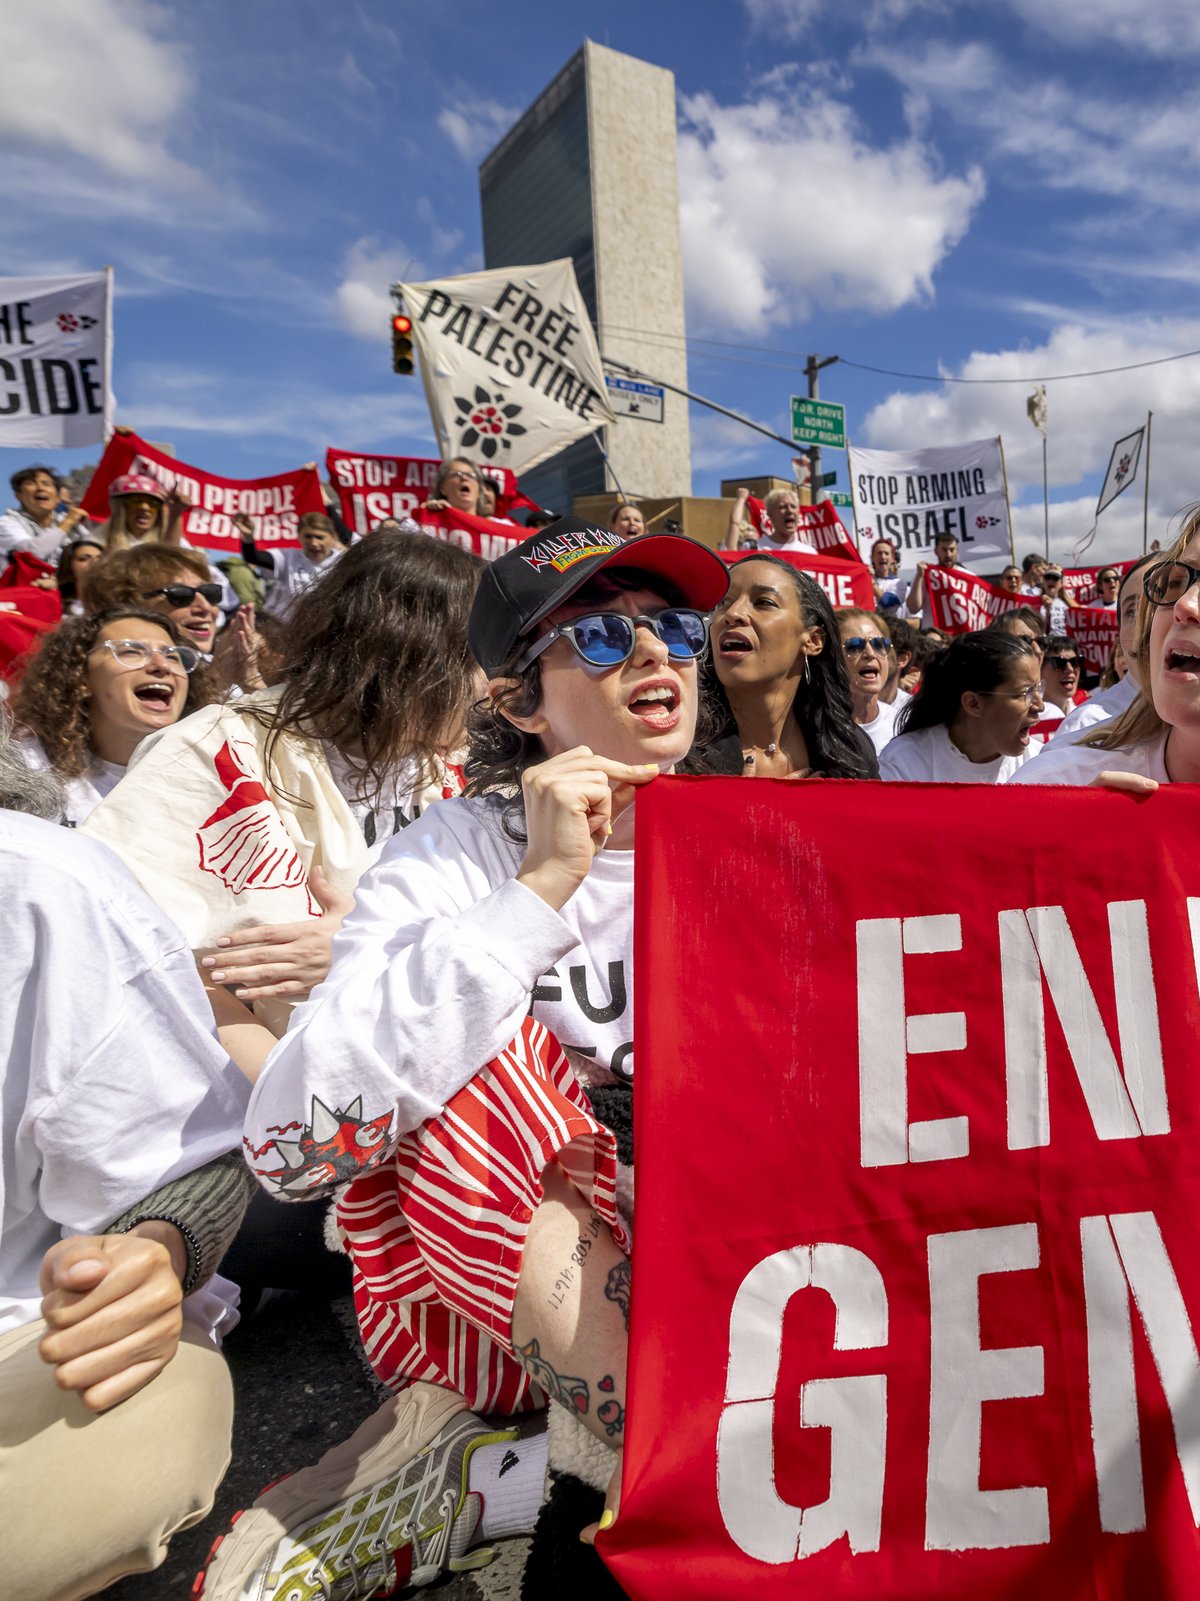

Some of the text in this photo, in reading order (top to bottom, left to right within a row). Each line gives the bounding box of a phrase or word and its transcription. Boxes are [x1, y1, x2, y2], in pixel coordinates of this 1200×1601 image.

[492, 281, 580, 357] FREE
[419, 289, 602, 421] PALESTINE
[804, 416, 834, 429] NORTH
[817, 406, 843, 420] DRIVE
[793, 427, 843, 443] KEEP RIGHT
[334, 457, 398, 488] STOP
[858, 467, 986, 506] STOP ARMING
[203, 482, 297, 516] PEOPLE
[794, 521, 848, 549] MING
[876, 506, 975, 550] ISRAEL
[555, 548, 586, 568] FROM
